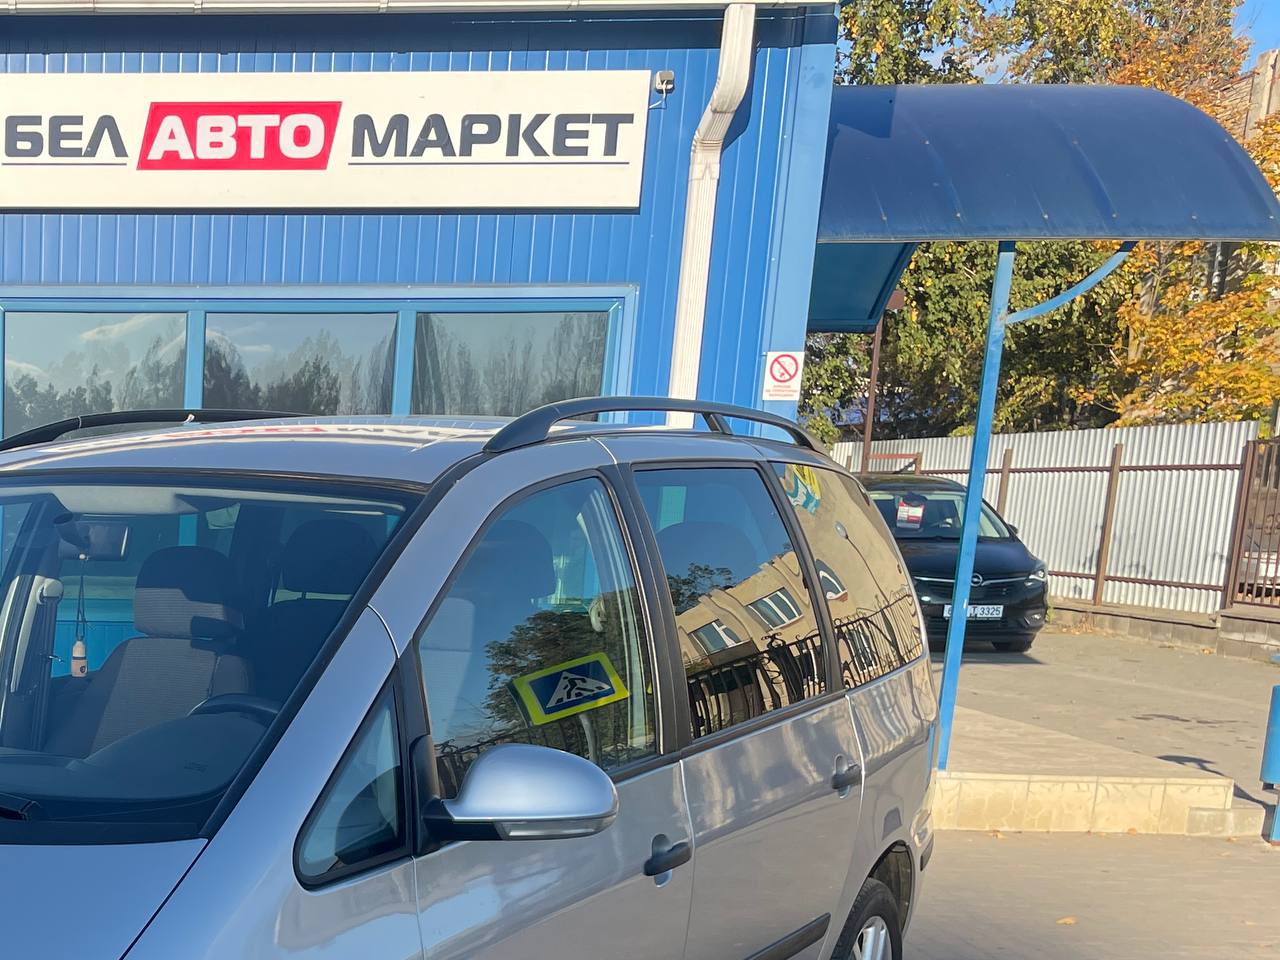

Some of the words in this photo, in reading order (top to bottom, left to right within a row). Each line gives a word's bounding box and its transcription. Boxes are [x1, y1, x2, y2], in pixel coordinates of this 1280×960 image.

[4, 115, 129, 158] БЕЛ
[146, 113, 312, 160] АВТО
[350, 113, 634, 158] МАРКЕТ
[979, 606, 1001, 616] 3325
